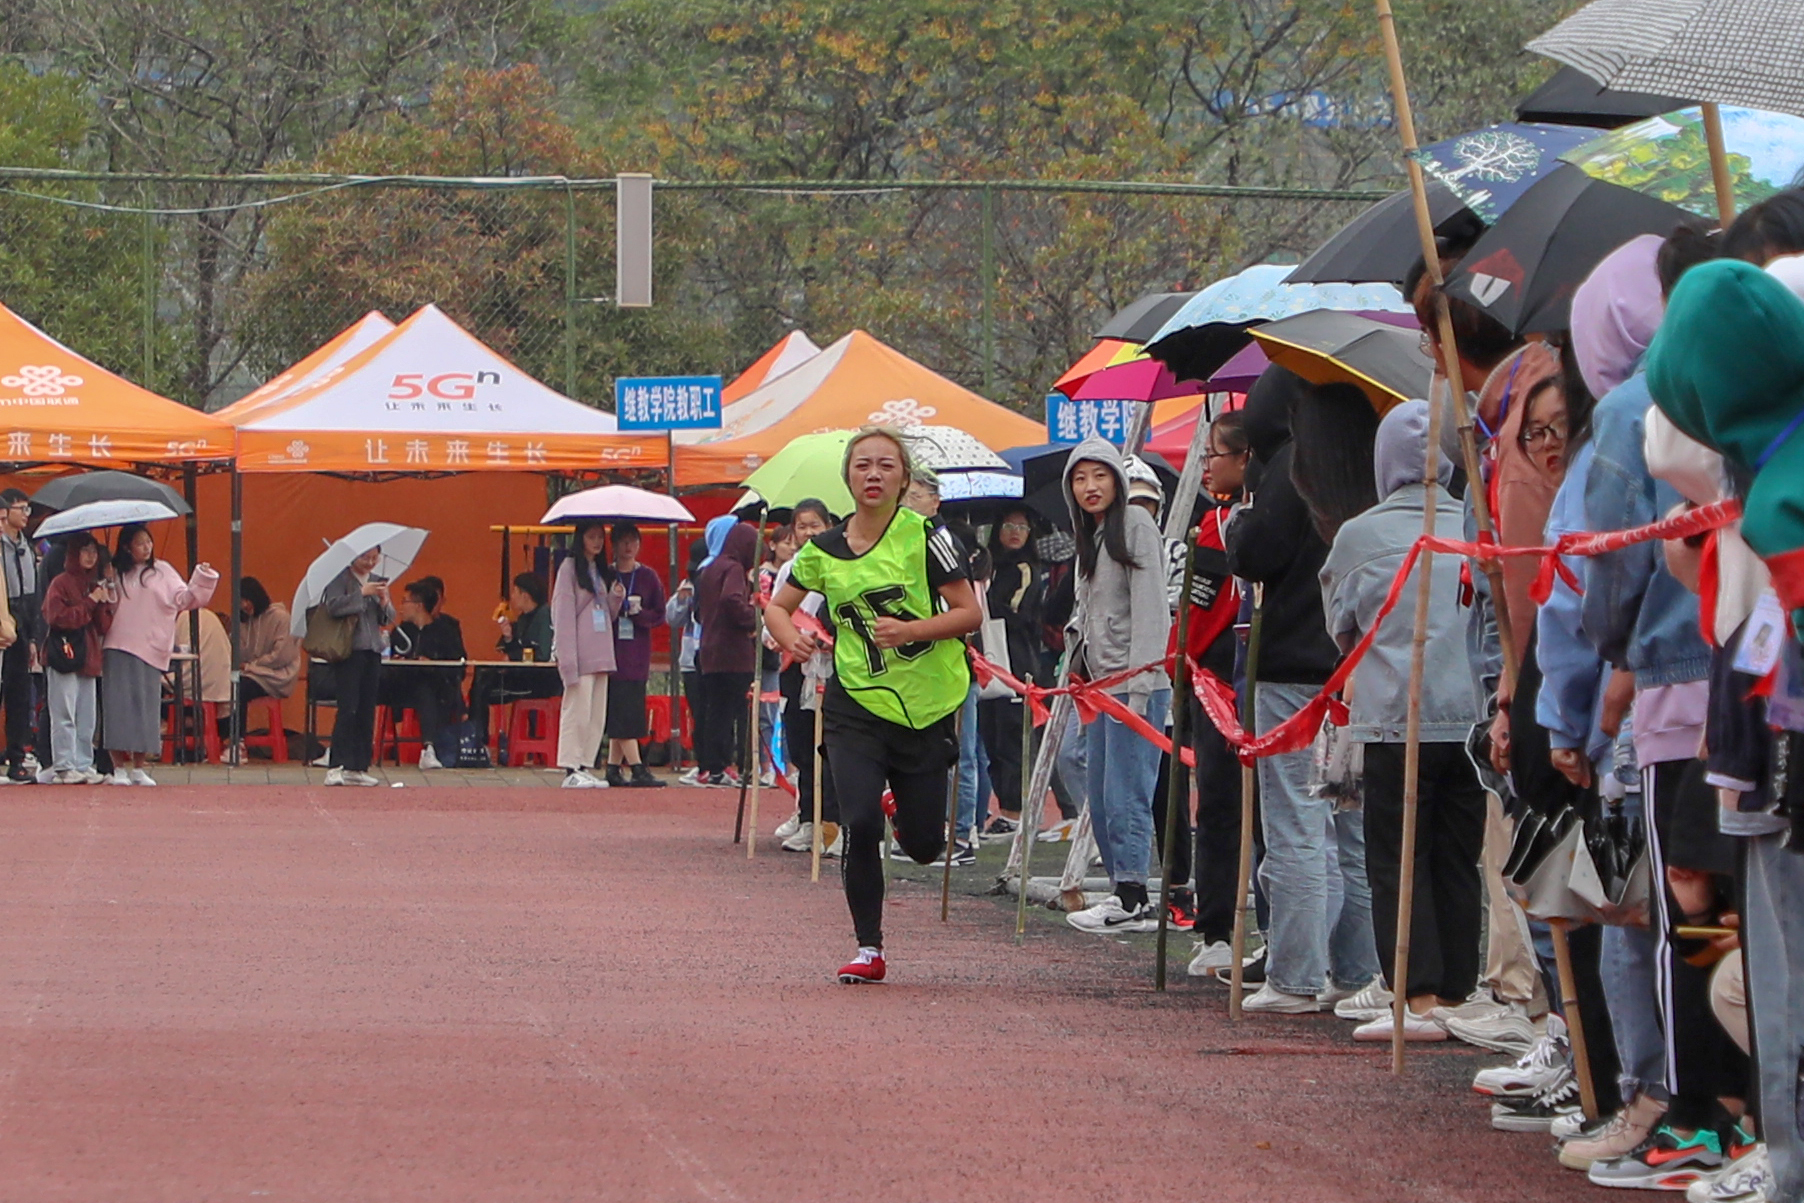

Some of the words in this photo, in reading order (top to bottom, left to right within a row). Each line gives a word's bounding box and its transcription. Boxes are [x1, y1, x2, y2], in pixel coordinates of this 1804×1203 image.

[624, 385, 716, 422] 继教学院教职工
[8, 432, 112, 457] 来生长
[365, 438, 547, 464] 让未来生长
[836, 584, 938, 678] 15
